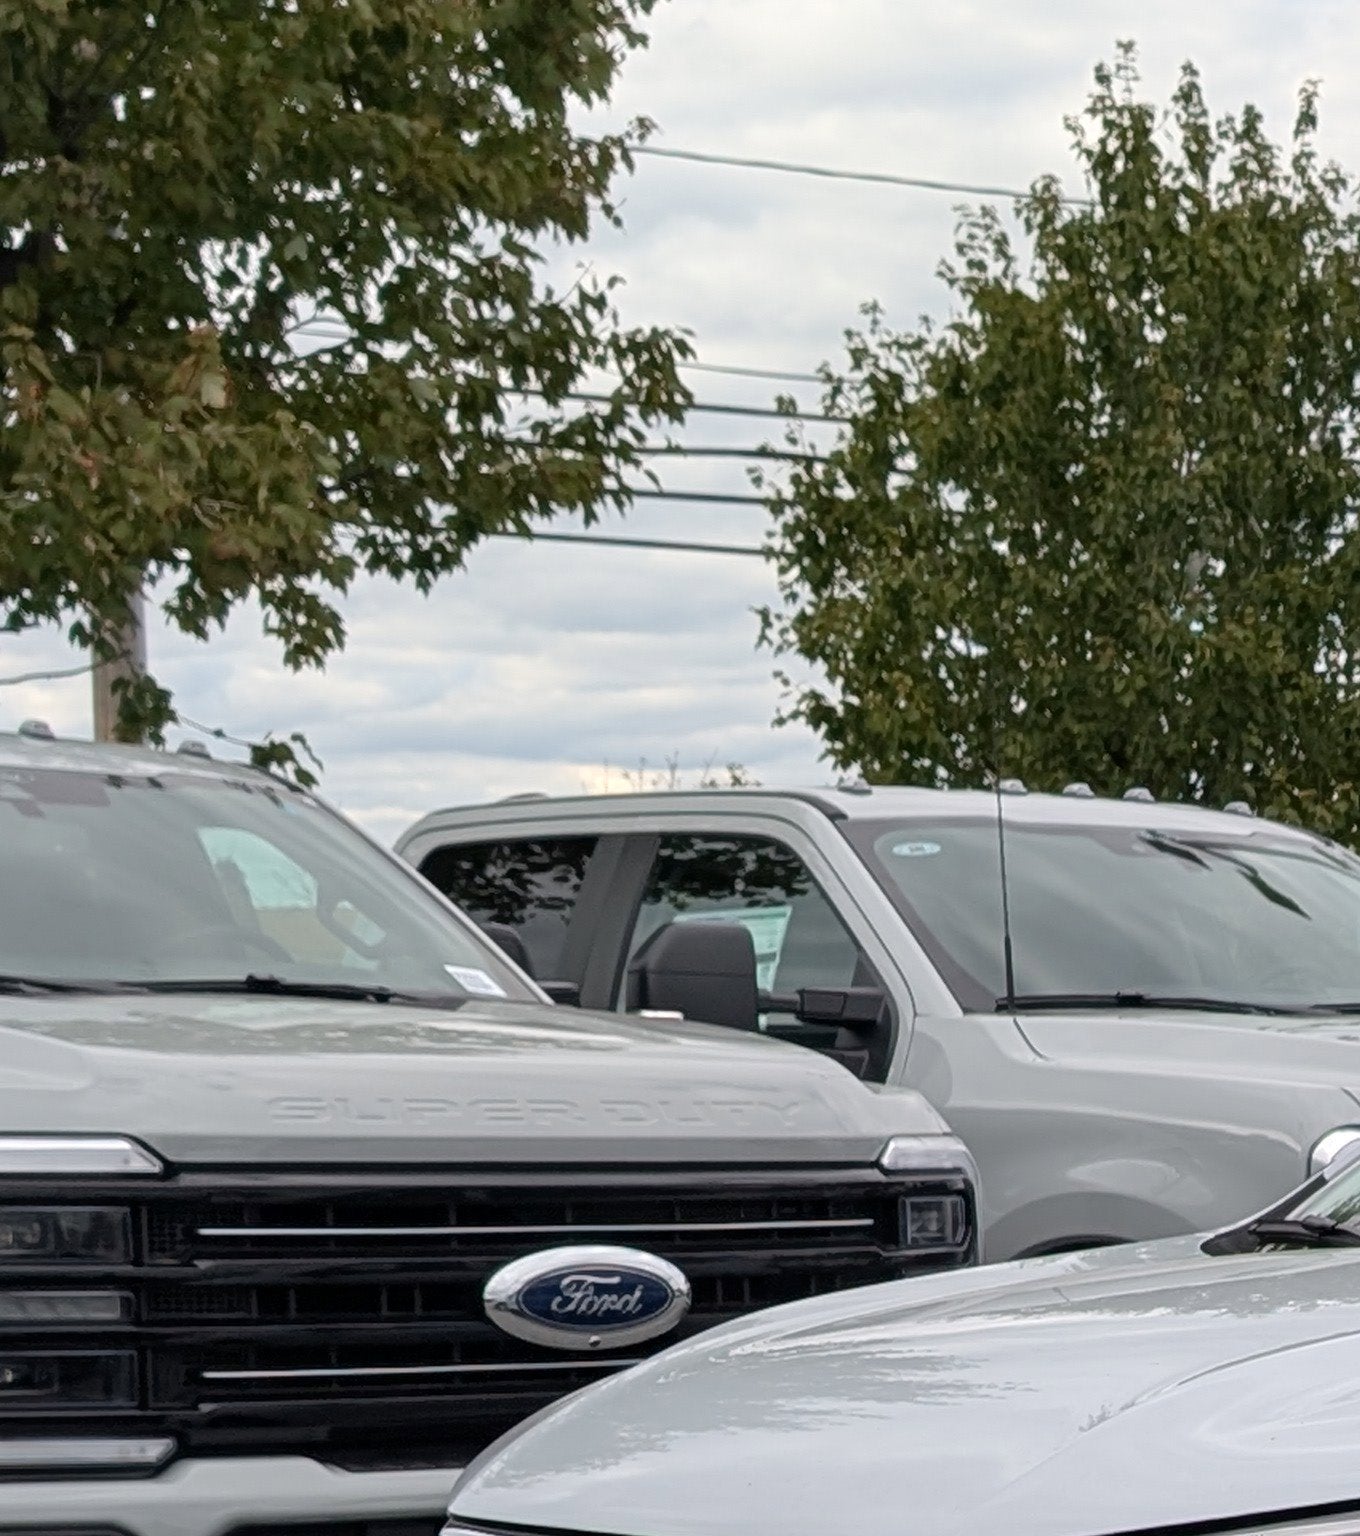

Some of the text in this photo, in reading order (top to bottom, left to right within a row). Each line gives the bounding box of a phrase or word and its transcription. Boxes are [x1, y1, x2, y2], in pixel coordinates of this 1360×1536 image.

[269, 1096, 802, 1128] SUPER DUTY
[550, 1273, 644, 1318] Ford
